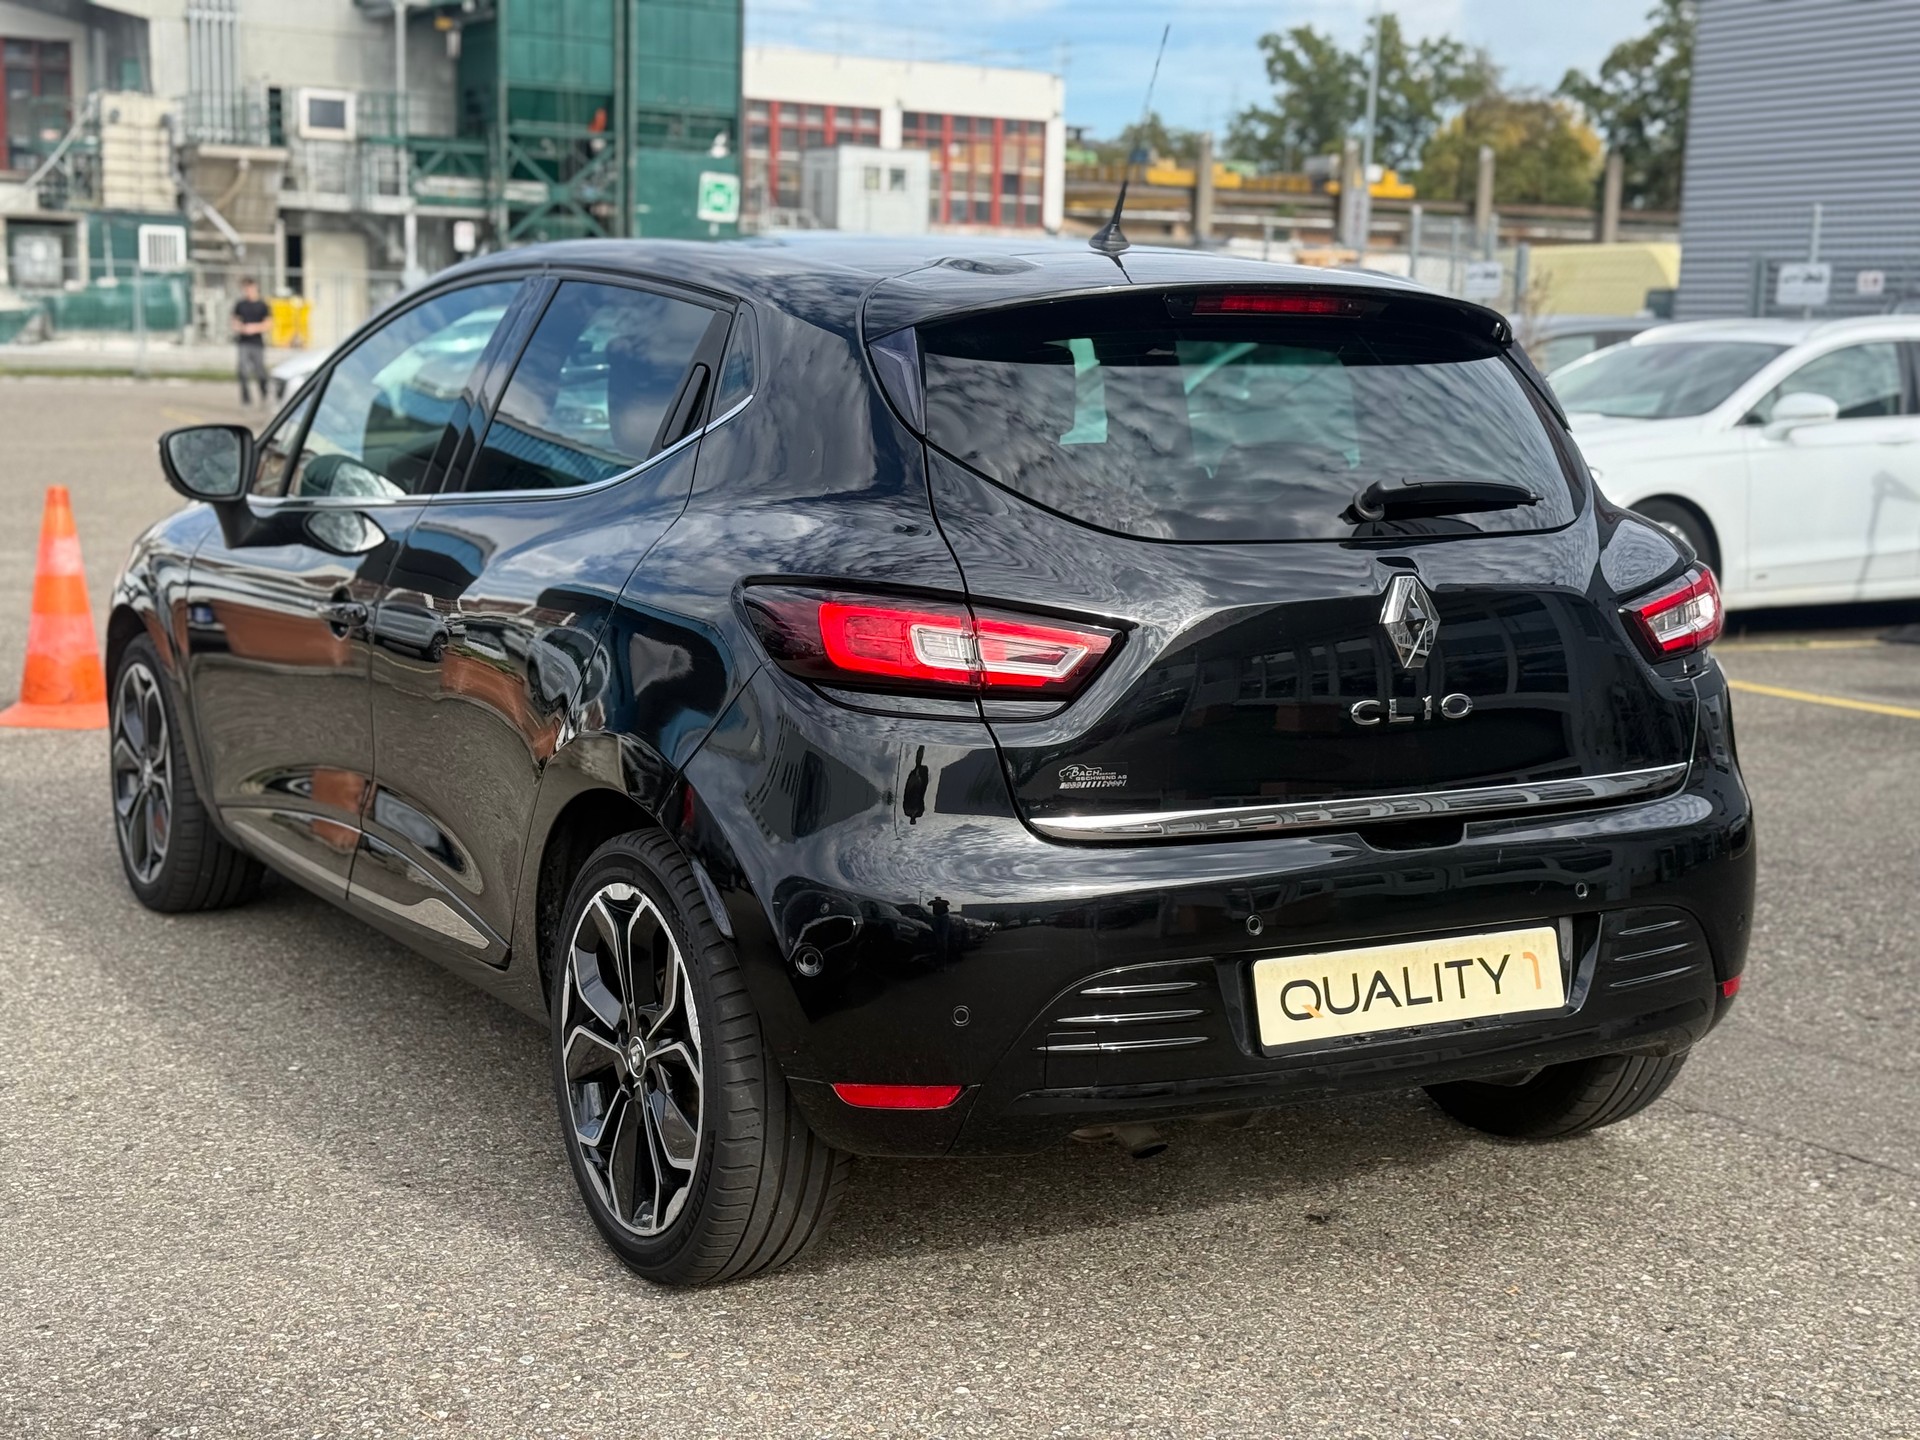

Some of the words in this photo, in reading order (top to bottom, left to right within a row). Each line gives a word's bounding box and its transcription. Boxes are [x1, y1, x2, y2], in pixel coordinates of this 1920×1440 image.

[1350, 693, 1473, 725] CLIO
[1069, 767, 1100, 777] BACH
[1280, 954, 1511, 1021] QUALITY
[1522, 952, 1542, 990] 1
